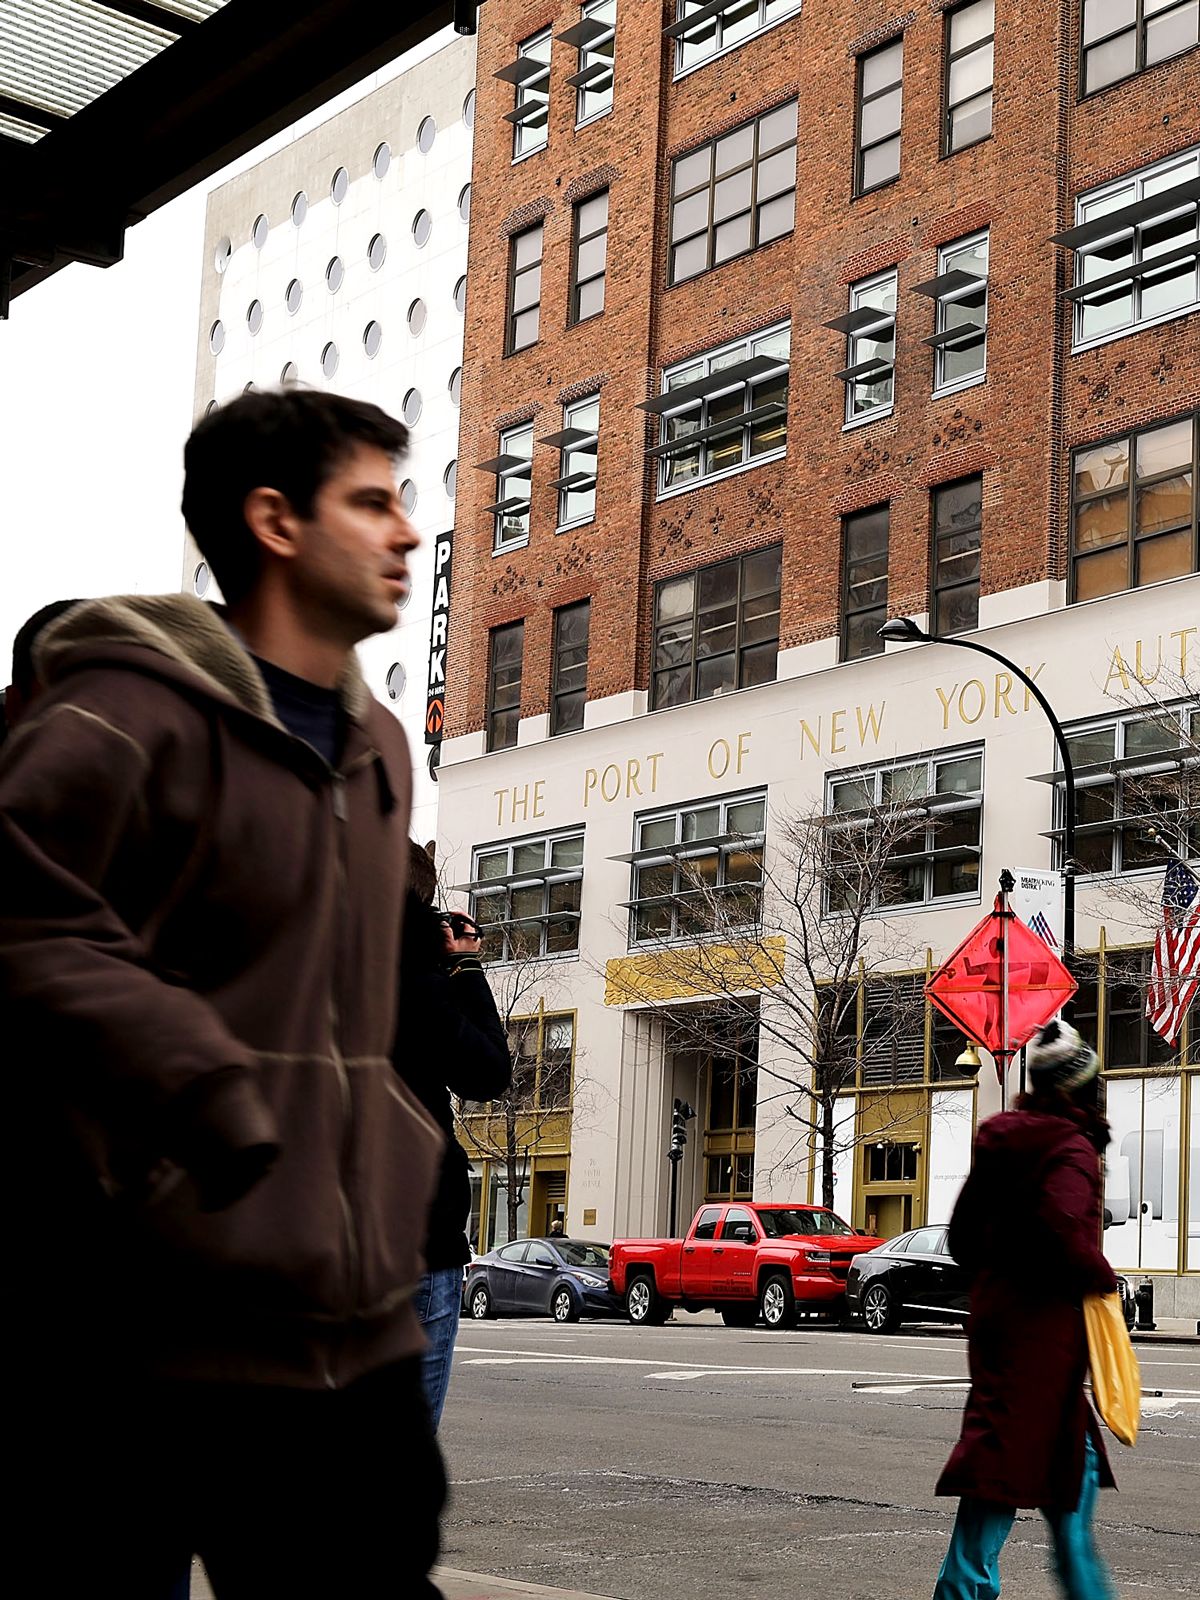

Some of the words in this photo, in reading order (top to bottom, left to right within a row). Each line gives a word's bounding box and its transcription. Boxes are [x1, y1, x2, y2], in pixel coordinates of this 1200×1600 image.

[430, 540, 451, 685] PARK
[428, 688, 434, 697] 24
[434, 685, 445, 695] HRS
[493, 780, 546, 826] THE
[583, 752, 665, 808] PORT
[707, 731, 752, 780] OF
[799, 700, 887, 761] NEW
[936, 662, 1046, 730] YORK
